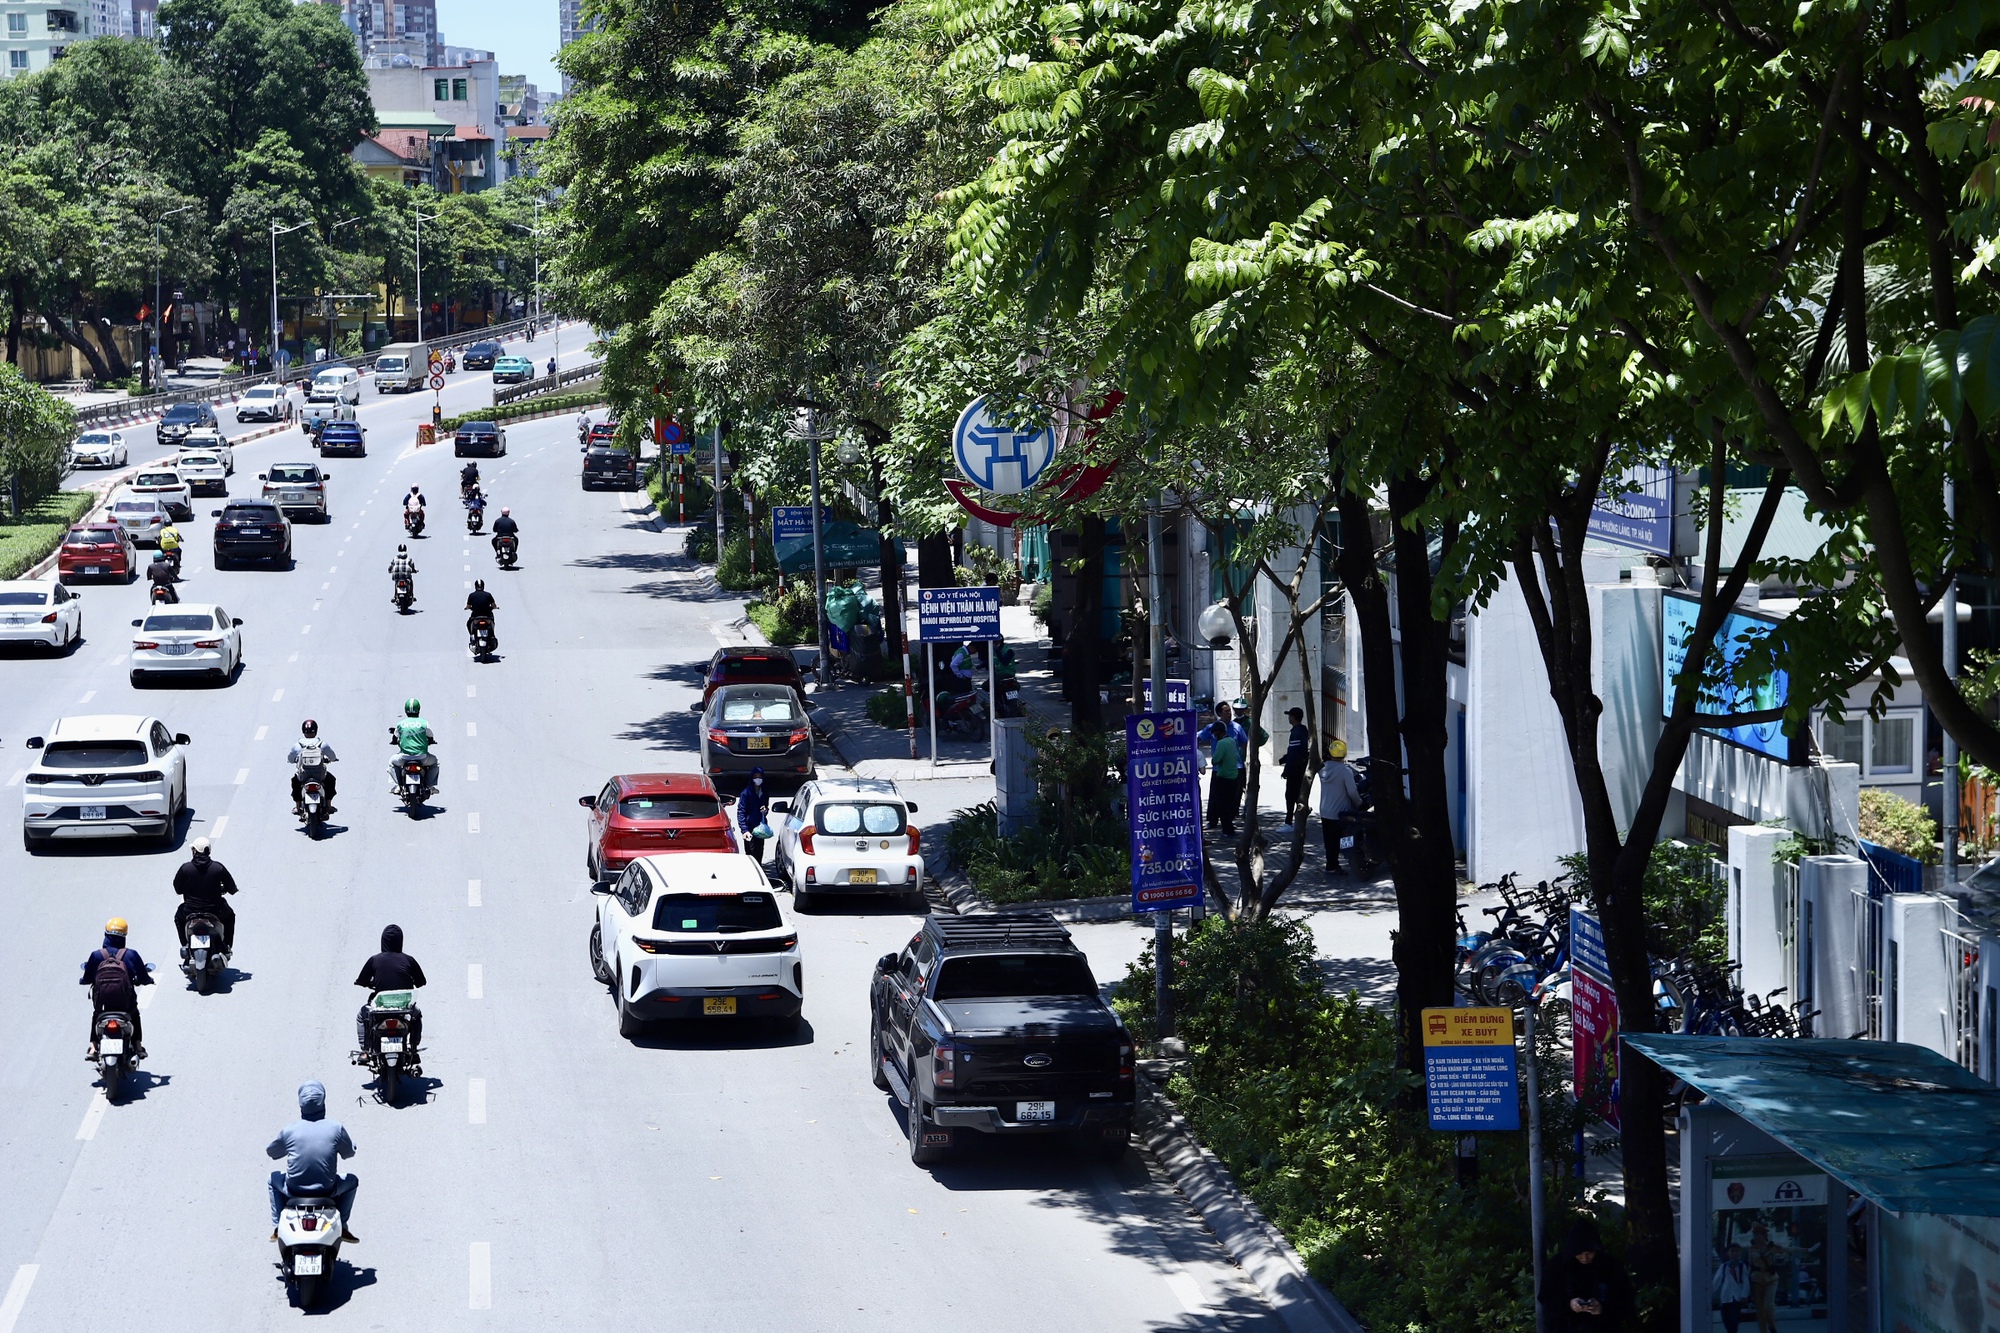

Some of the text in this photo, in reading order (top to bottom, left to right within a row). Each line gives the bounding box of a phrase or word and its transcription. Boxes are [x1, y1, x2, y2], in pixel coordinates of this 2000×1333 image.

[1624, 502, 1657, 524] CONTROL
[969, 591, 980, 599] NỘI
[921, 598, 998, 616] BỆNH VIỆN THẬN HÀ NỘI
[921, 615, 998, 625] HANOI NEPHROLOGY HOSPITAL
[1178, 693, 1186, 703] XE
[1134, 757, 1191, 779] ƯU ĐÃI
[1151, 778, 1162, 786] XÉT
[1138, 788, 1191, 807] KIỂM TRA
[1137, 806, 1193, 823] SỨC KHỎE
[1134, 822, 1196, 840] TỔNG QUÁT
[1150, 888, 1193, 899] 1900 56 56 56
[712, 998, 728, 1006] 29E
[1454, 1010, 1505, 1024] ĐIỂM DỪNG
[1461, 1026, 1498, 1037] XE BUÝT
[1027, 1102, 1045, 1111] 29H
[1020, 1111, 1051, 1120] 682.15
[926, 1135, 947, 1143] ARB
